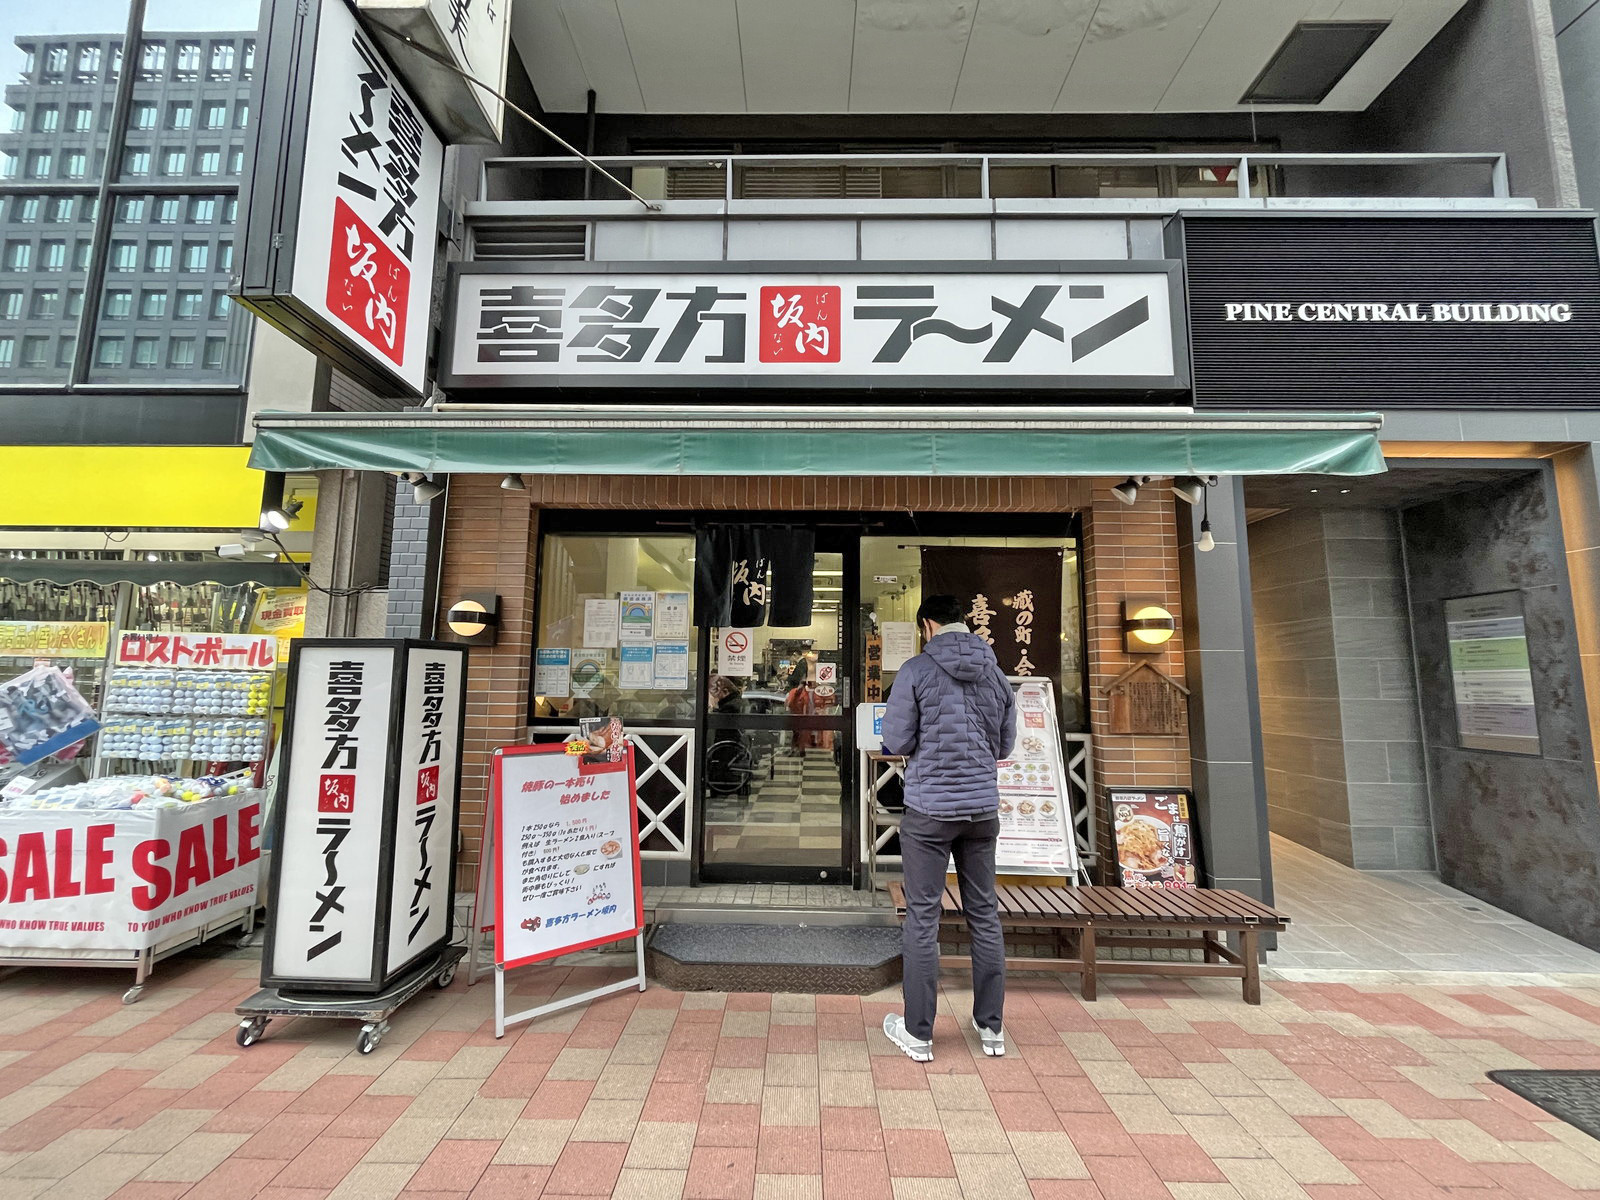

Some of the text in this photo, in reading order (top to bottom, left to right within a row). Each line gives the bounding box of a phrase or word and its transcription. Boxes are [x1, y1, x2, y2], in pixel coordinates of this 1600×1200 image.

[337, 29, 388, 201] ラーメン
[378, 83, 424, 262] 喜多方
[345, 223, 397, 350] 坂内
[1225, 303, 1573, 322] PINE CENTRAL BUILDING
[477, 285, 746, 363] 喜多方
[770, 292, 830, 356] 坂内
[853, 284, 1150, 363] ラーメン
[261, 605, 305, 620] 現金買取
[120, 636, 274, 667] ロストボール
[867, 644, 881, 700] 営業中
[321, 661, 364, 769] 喜多方
[418, 662, 446, 764] 喜多方
[324, 778, 350, 810] 坂内
[421, 771, 436, 798] 坂内
[521, 776, 596, 792] 焼豚の一本売り
[559, 790, 611, 805] 始めました
[0, 824, 115, 904] ALE
[131, 803, 261, 912] SALE
[307, 818, 351, 961] ラーメン
[407, 804, 436, 946] ラーメン
[19, 920, 46, 931] KNOW
[49, 921, 68, 931] TRUE
[71, 921, 105, 932] VALUES
[128, 884, 254, 932] TO YOU WHO KNOW TRUE VALUES
[545, 904, 618, 929] 喜多方ラーメン坂内
